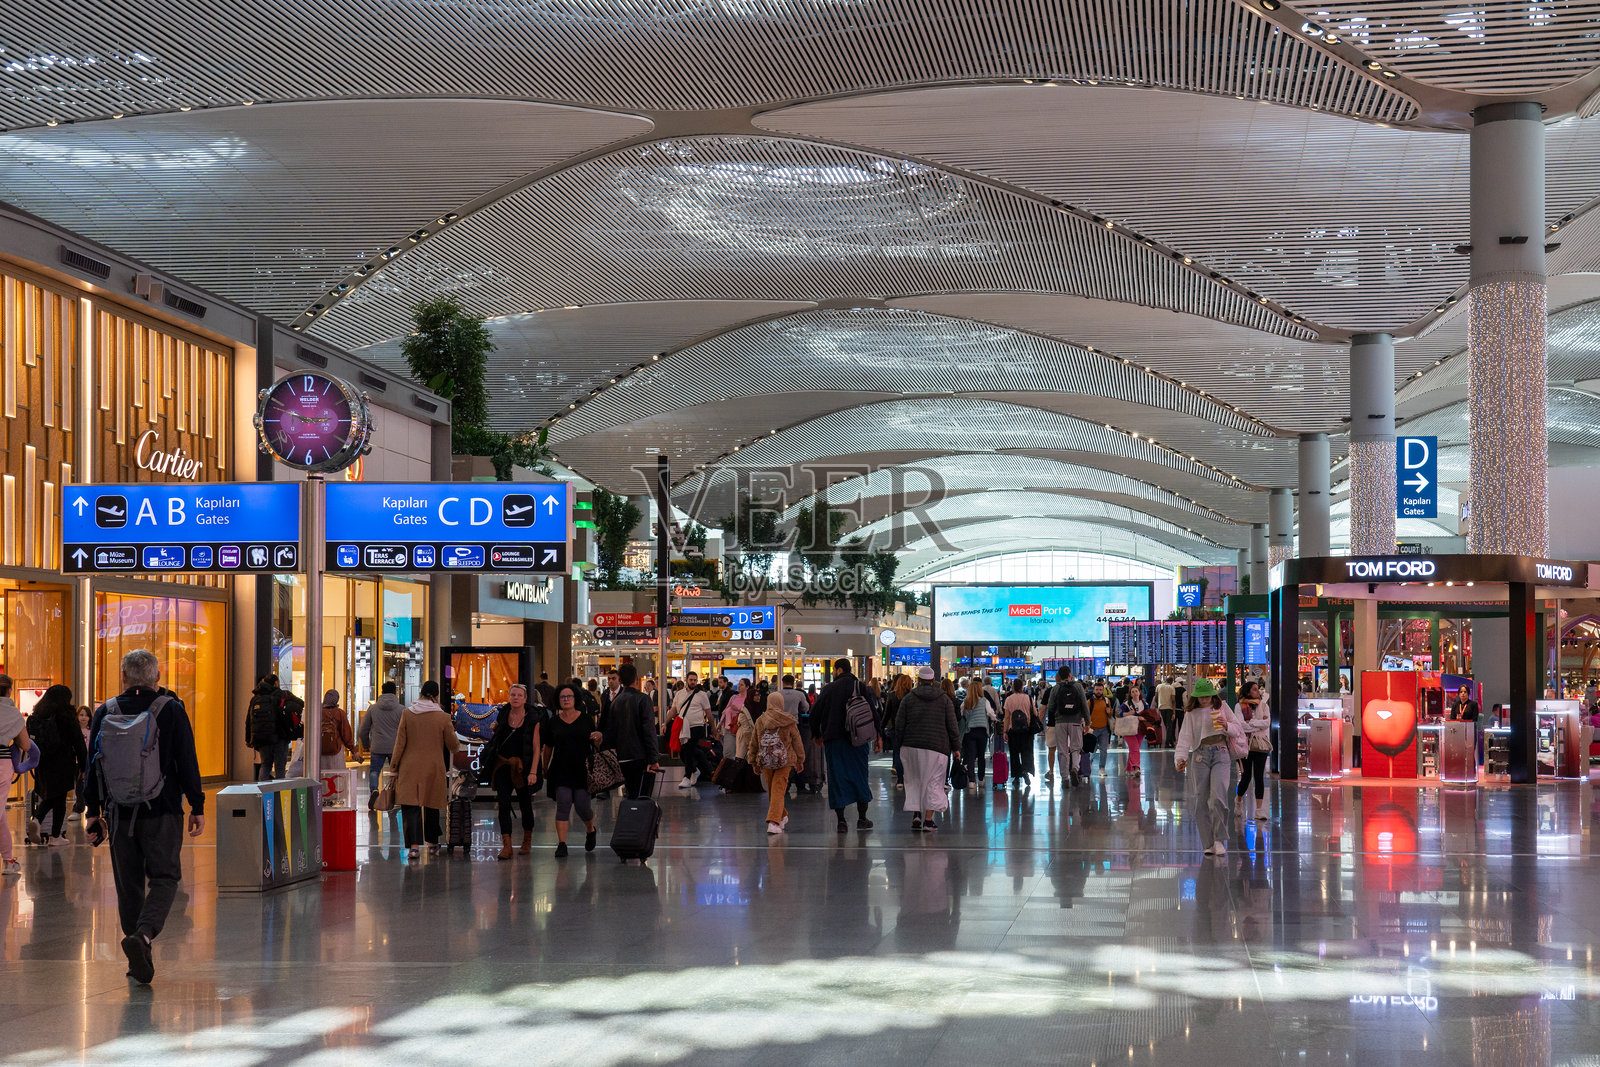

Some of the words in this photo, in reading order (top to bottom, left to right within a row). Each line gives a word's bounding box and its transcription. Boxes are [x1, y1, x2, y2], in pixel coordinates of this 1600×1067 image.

[303, 375, 315, 392] 12
[136, 429, 203, 480] Cartier
[305, 449, 312, 465] 6
[1404, 438, 1429, 469] D
[195, 496, 240, 510] Kapıları
[382, 496, 428, 510] Kapıları
[1403, 497, 1431, 506] Kapıları
[135, 497, 158, 526] A
[168, 497, 186, 526] B
[196, 513, 230, 525] Gates
[393, 513, 428, 525] Gates
[438, 497, 459, 526] C
[470, 497, 493, 526] D
[1403, 507, 1425, 515] Gates
[1345, 561, 1383, 577] TOM
[1386, 560, 1436, 576] FORD
[1535, 563, 1552, 579] TOM
[1552, 565, 1573, 581] FORD
[507, 581, 549, 605] MONTBLANC
[739, 612, 749, 625] D
[1010, 607, 1041, 615] Media
[1043, 606, 1061, 615] Port
